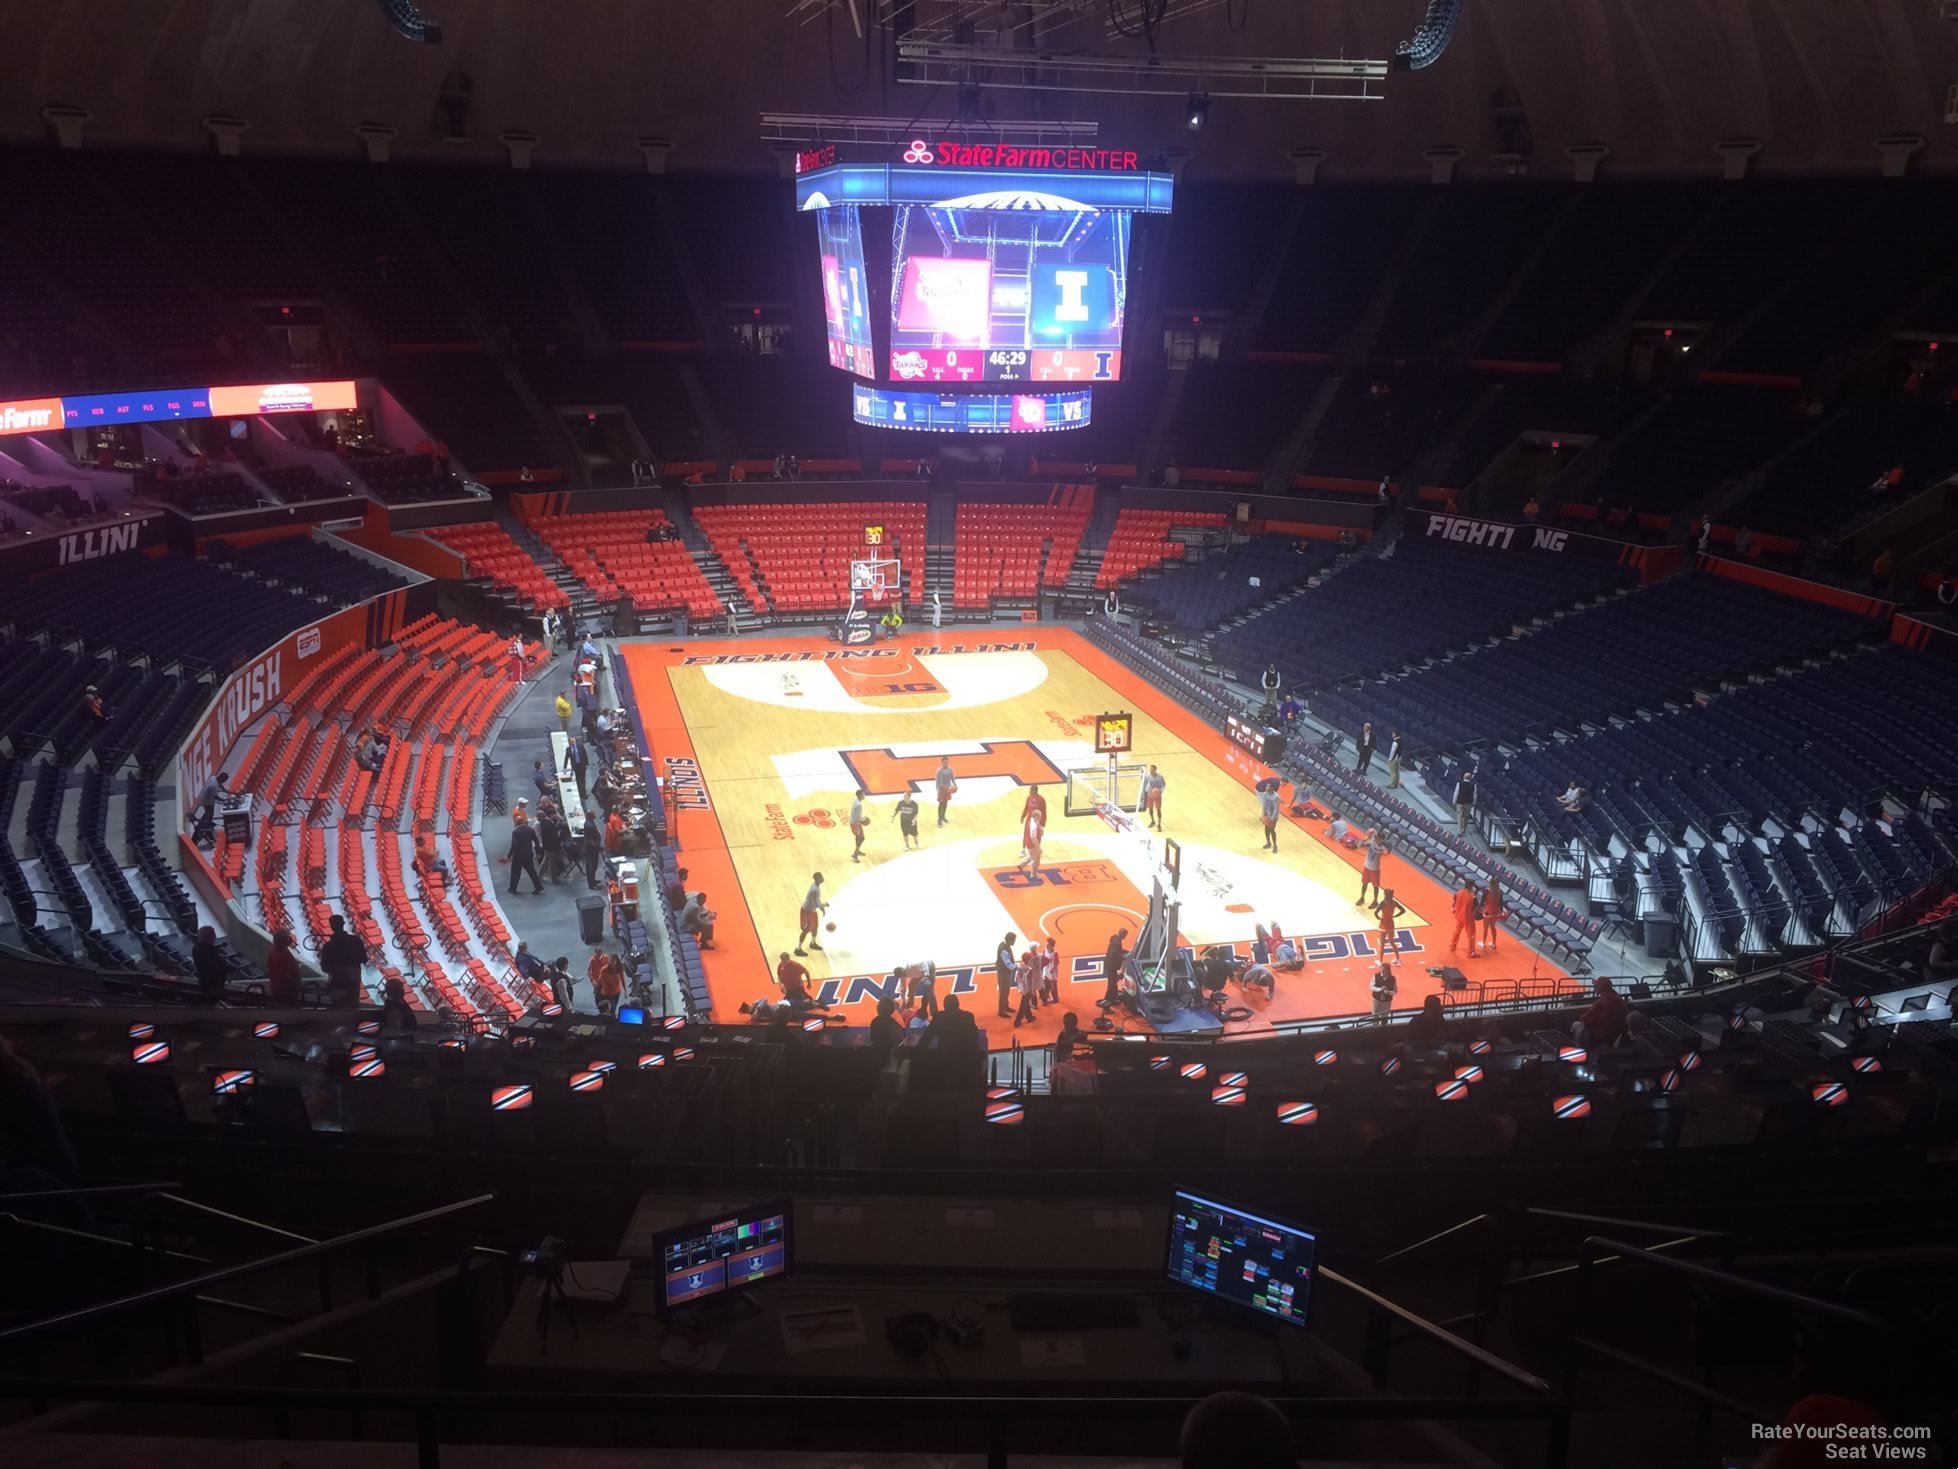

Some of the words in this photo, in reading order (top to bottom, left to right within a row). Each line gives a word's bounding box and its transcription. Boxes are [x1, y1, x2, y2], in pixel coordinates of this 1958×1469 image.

[1051, 151, 1137, 170] CENTER
[946, 351, 957, 367] 0
[989, 351, 1026, 365] 46:29
[117, 405, 130, 413] AST
[59, 522, 140, 566] ILLINI
[680, 647, 900, 666] FIGHTING
[911, 642, 1037, 656] ILLINI
[217, 651, 281, 755] KRUSH
[664, 757, 712, 811] ILLINOIS
